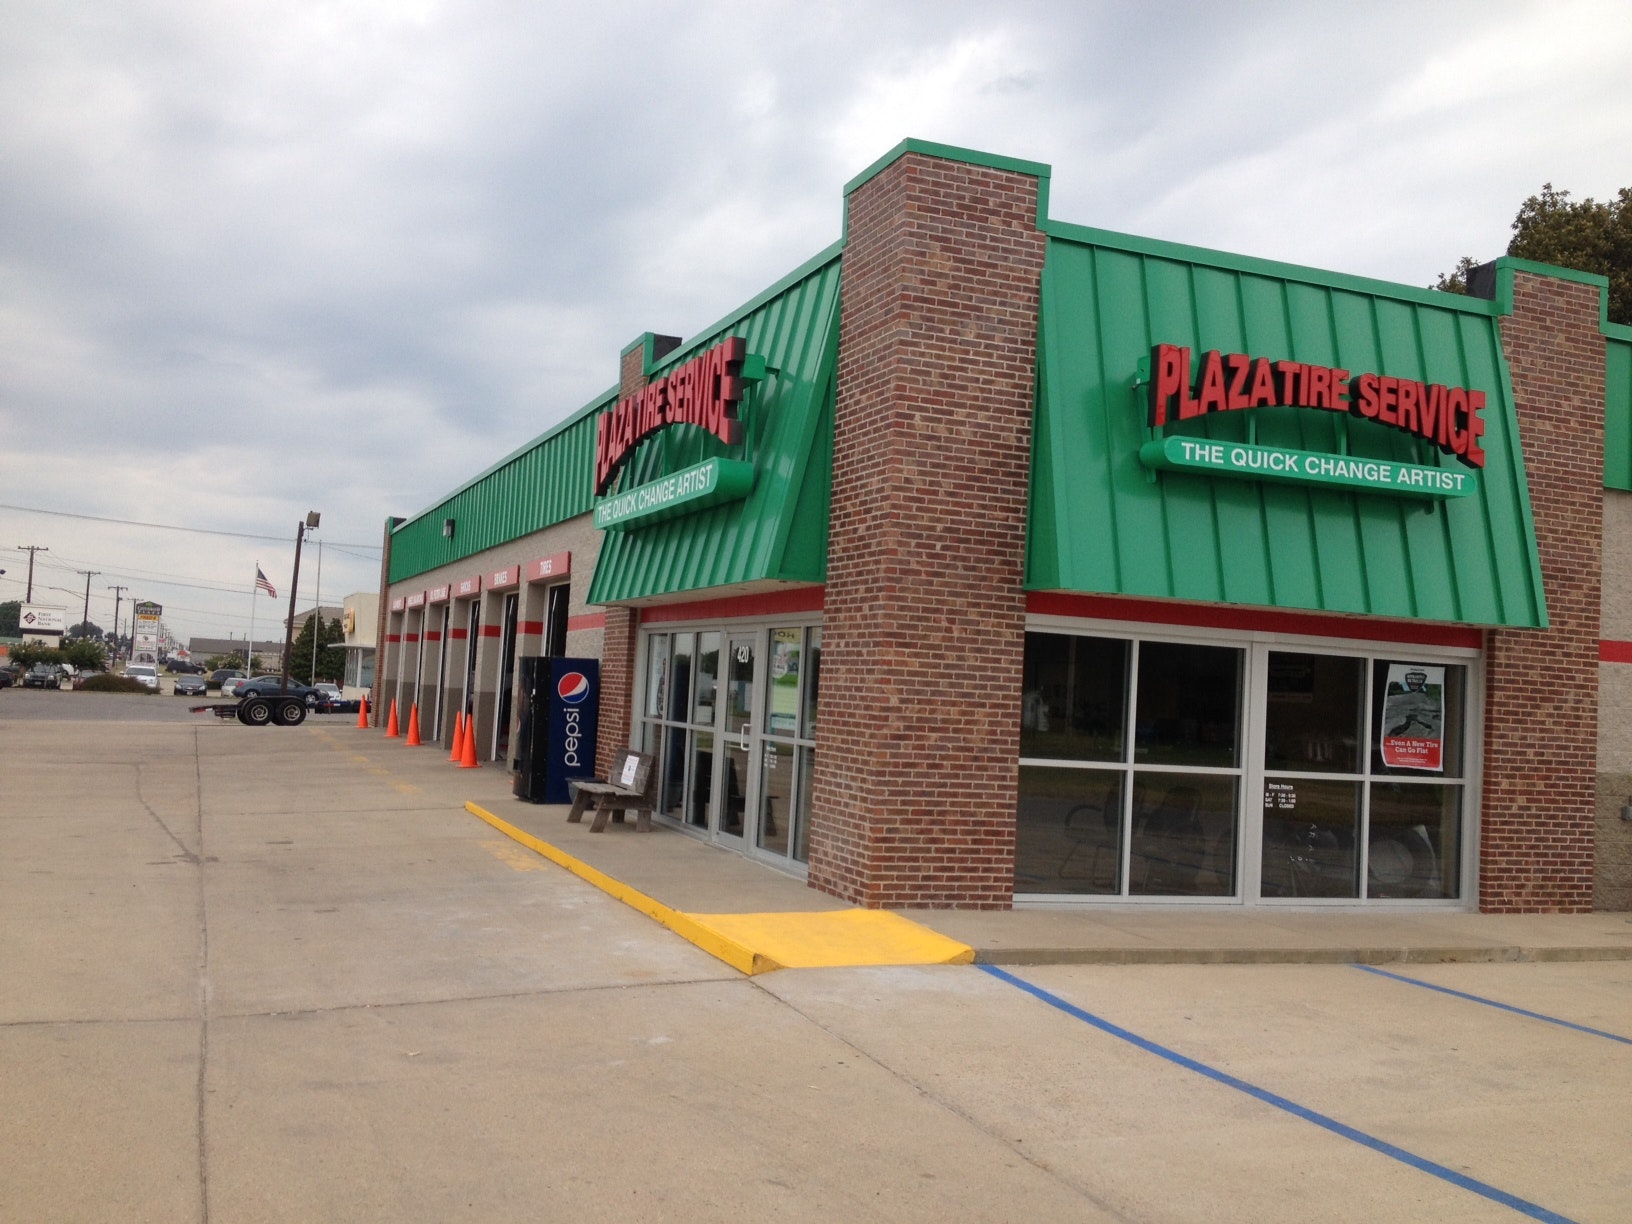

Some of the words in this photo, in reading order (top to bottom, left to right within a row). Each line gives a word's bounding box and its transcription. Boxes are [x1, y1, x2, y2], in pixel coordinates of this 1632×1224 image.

[594, 394, 636, 496] PLAZA
[635, 377, 669, 439] TIRE
[666, 336, 741, 446] SERVICE
[1150, 343, 1277, 427] PLAZA
[1276, 360, 1350, 412] TIRE
[1357, 372, 1486, 468] SERVICE
[597, 501, 612, 524] THE
[612, 492, 637, 519] QUICK
[638, 479, 675, 509] CHANGE
[676, 464, 713, 497] ARTIST
[1181, 441, 1225, 464] THE
[1230, 448, 1300, 473] QUICK
[1304, 456, 1392, 484] CHANGE
[1397, 467, 1466, 491] ARTIST
[540, 559, 552, 575] TIRES
[737, 646, 750, 664] 420
[563, 707, 582, 767] pepsi
